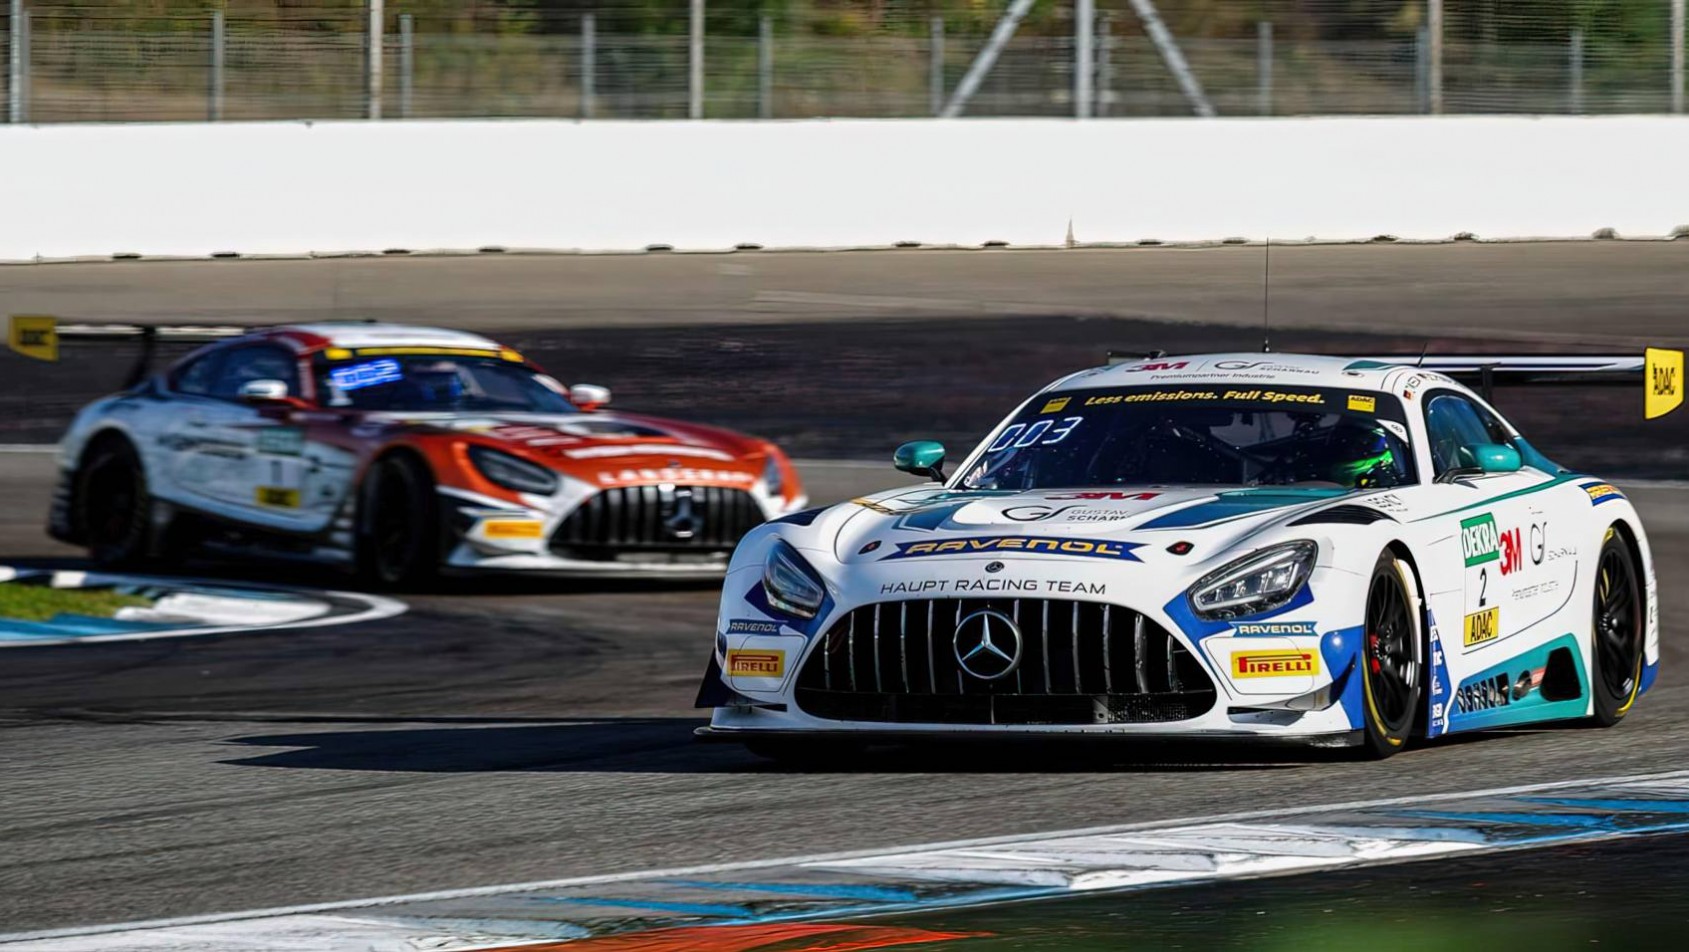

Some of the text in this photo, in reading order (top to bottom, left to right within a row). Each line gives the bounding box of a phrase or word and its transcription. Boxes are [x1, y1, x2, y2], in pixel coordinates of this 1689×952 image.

[1125, 361, 1190, 373] 3M
[1085, 390, 1325, 406] Less emissions. Full Speed.
[987, 416, 1084, 452] 003
[1045, 492, 1160, 501] 3M
[906, 538, 1121, 556] RAVENOL
[1462, 520, 1499, 560] DEKRA
[1499, 526, 1523, 577] 3M
[880, 579, 1106, 595] HAUPT RACING TEAM
[1479, 567, 1487, 608] 2
[730, 622, 778, 633] RAVENOL
[1238, 624, 1313, 634] RAVENOL
[1470, 611, 1493, 642] ADAC
[730, 654, 779, 673] PIRELLI
[1237, 653, 1312, 673] PIRELLI
